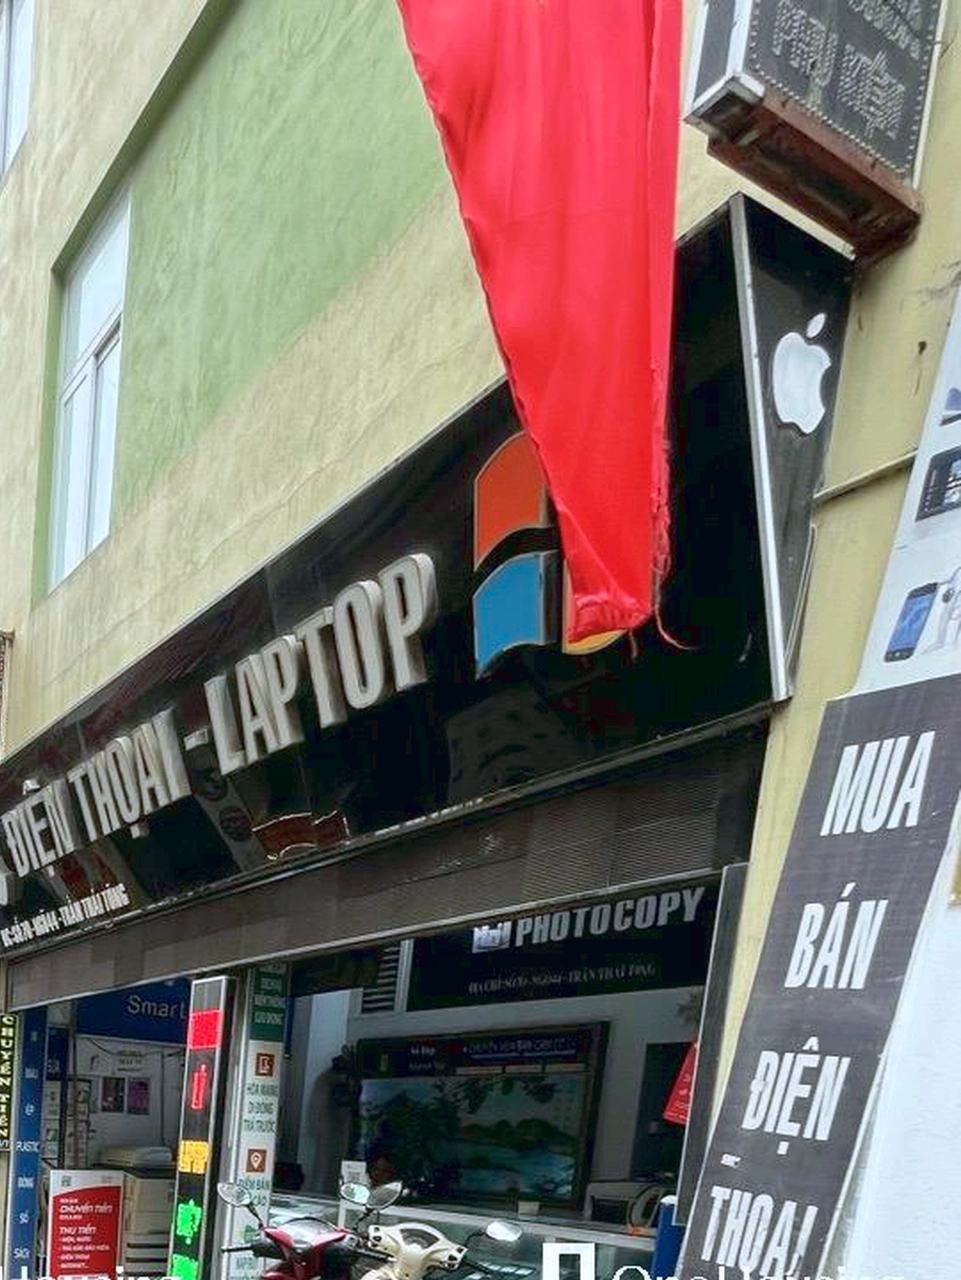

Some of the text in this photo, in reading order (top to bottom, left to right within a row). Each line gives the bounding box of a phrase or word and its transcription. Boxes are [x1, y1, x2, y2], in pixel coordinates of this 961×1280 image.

[1, 779, 80, 878] ĐIỆN
[68, 706, 192, 843] THOẠI
[204, 553, 438, 775] LAPTOP
[820, 730, 936, 837] MUA
[515, 887, 706, 948] PHOTOCOPY
[784, 881, 889, 989] BÁN
[15, 1140, 39, 1152] PLASTIC
[741, 1037, 851, 1155] ĐIỆN
